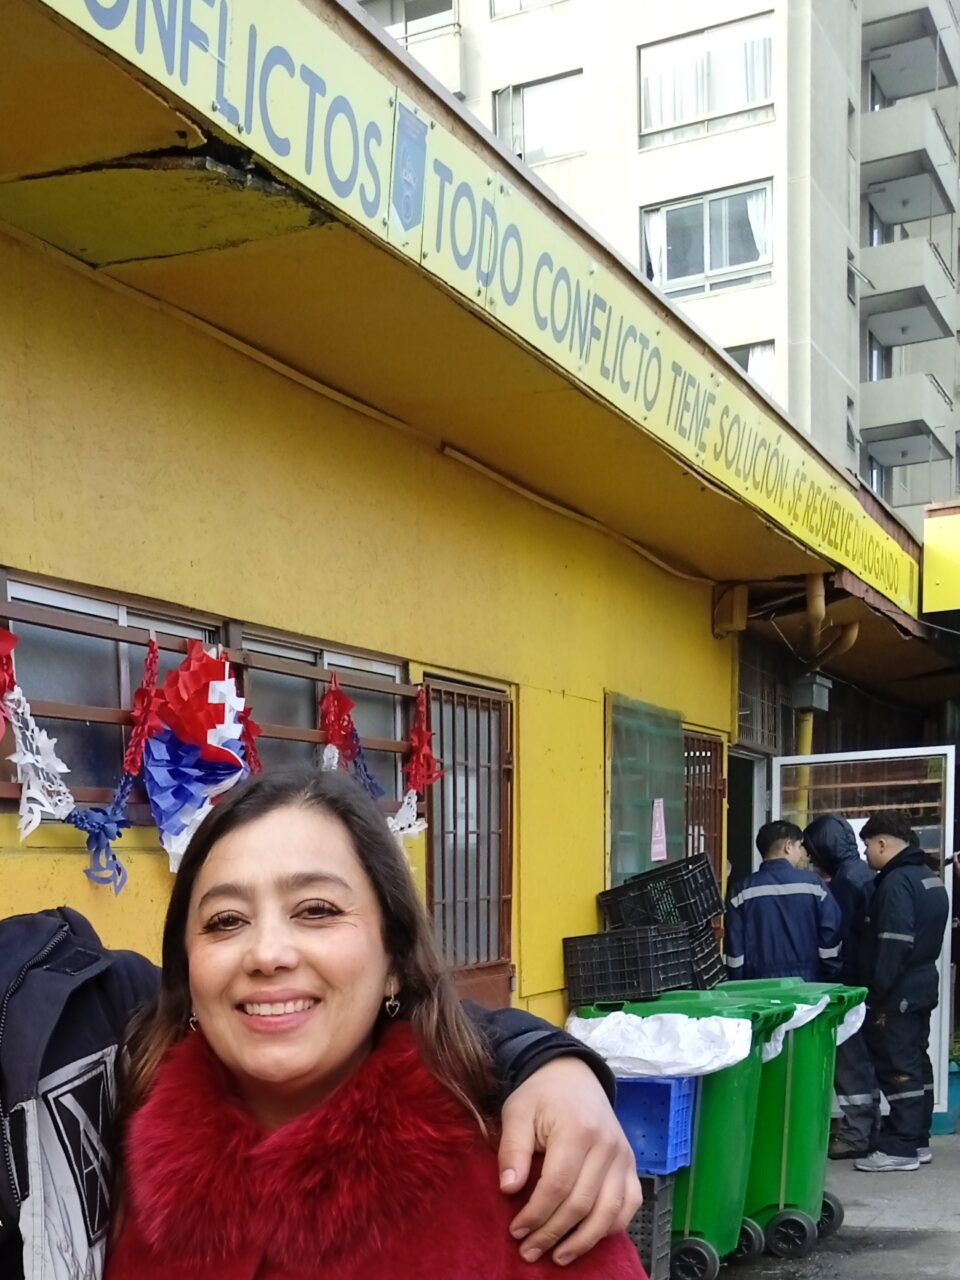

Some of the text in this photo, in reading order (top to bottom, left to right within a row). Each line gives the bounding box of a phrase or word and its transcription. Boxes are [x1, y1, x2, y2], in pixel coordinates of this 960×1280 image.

[83, 0, 383, 219] NFLICTOS
[432, 157, 524, 306] TODO
[532, 252, 662, 412] CONFLICTO
[665, 360, 716, 453] TIENE
[788, 467, 807, 523] SE
[802, 480, 854, 558] RESUELVE
[851, 518, 900, 594] DIALOGANDO
